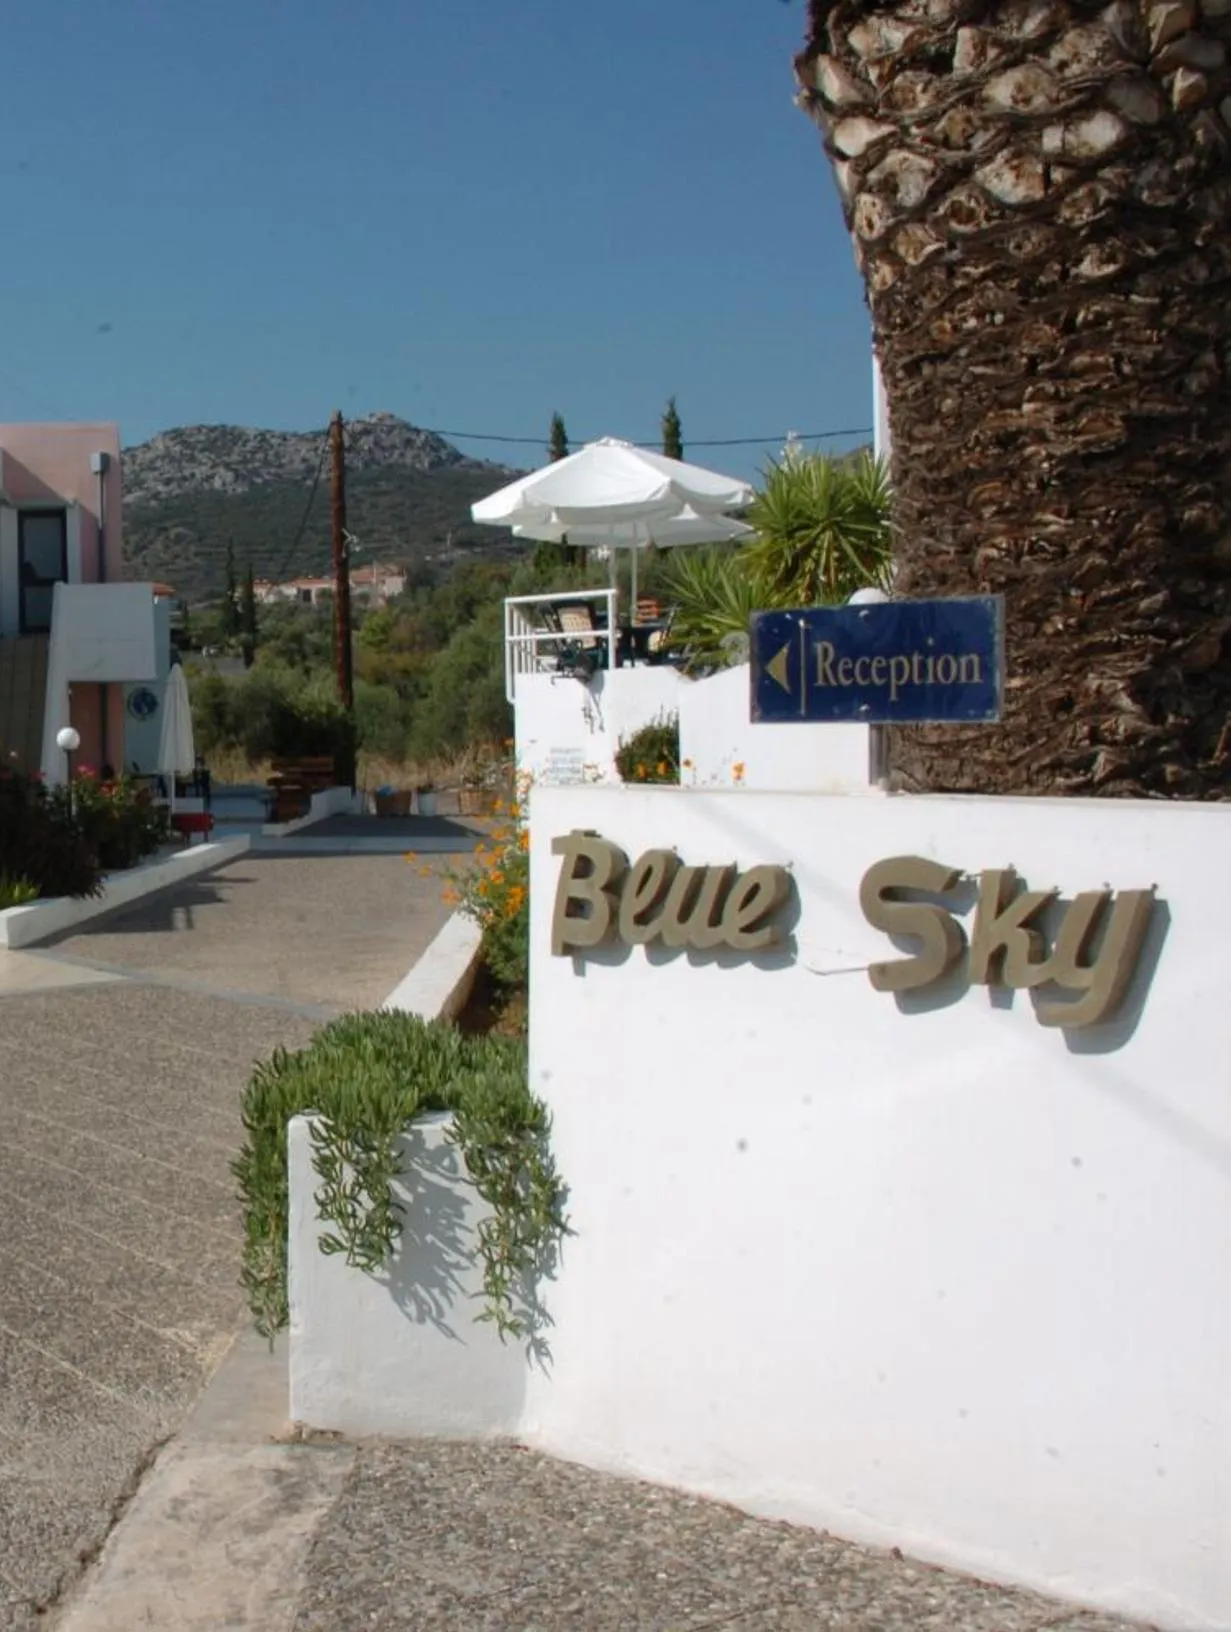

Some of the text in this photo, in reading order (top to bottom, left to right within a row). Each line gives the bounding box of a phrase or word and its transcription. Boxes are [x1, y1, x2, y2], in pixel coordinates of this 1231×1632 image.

[814, 640, 984, 702] Reception
[550, 829, 1160, 1028] Blue Sky
